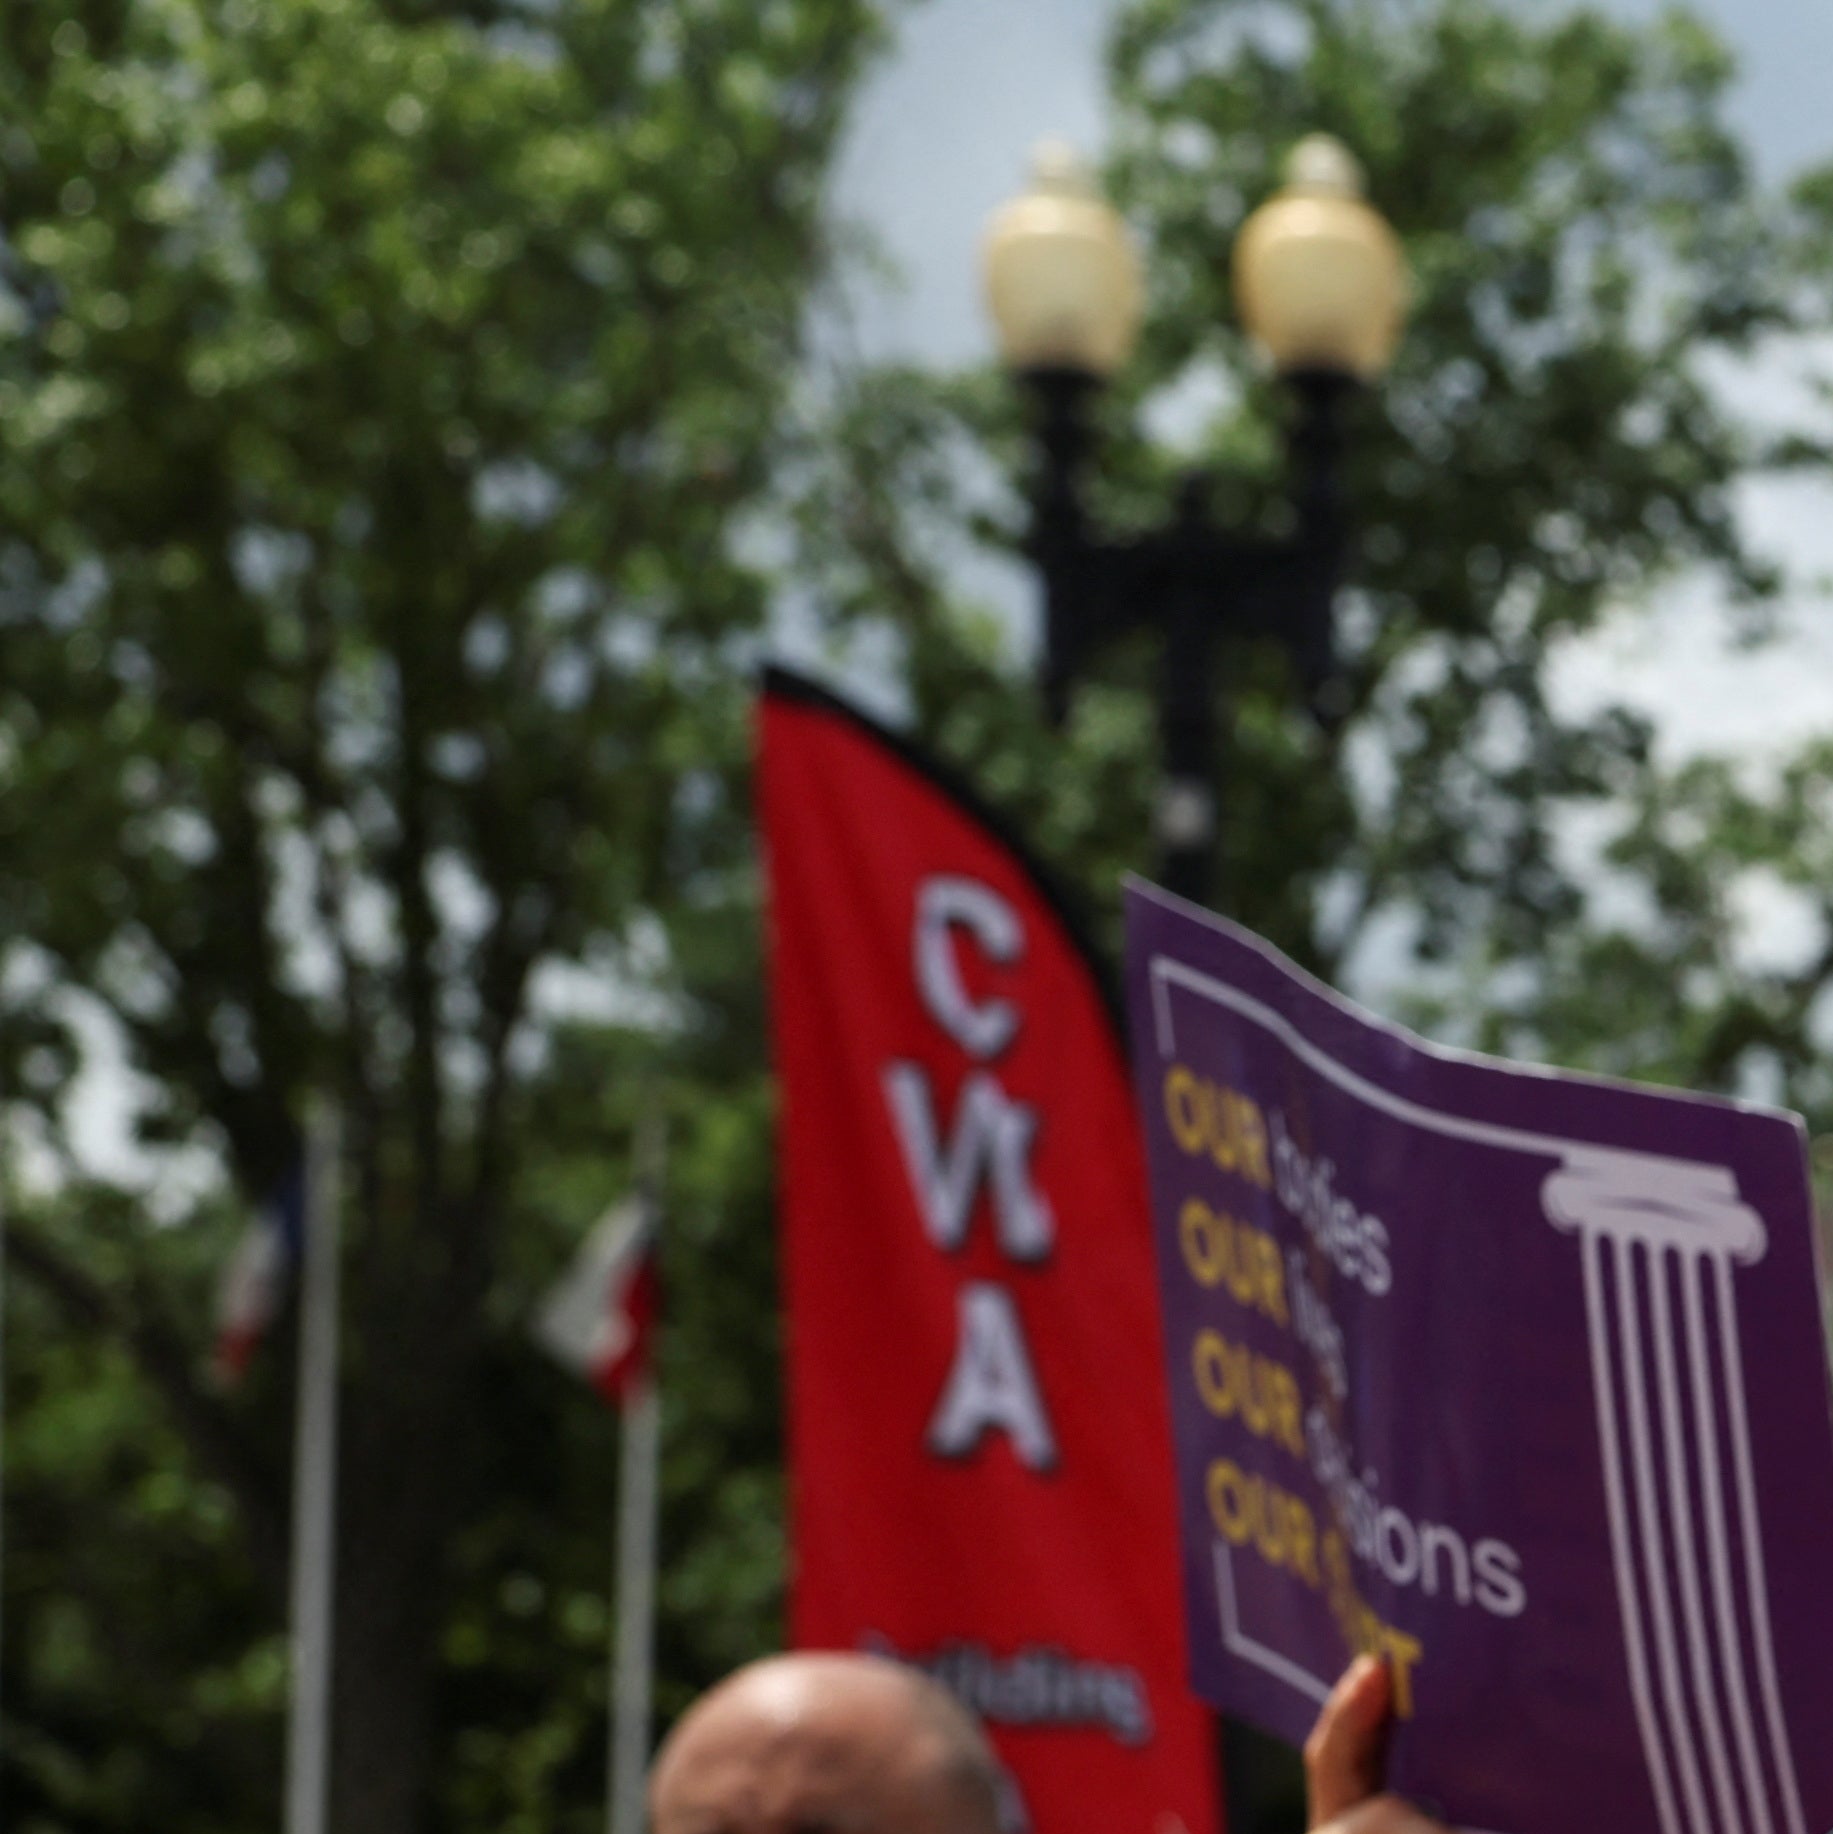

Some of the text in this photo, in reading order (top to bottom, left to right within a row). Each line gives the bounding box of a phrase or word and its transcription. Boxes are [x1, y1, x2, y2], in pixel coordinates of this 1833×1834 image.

[882, 870, 1060, 1474] CWA
[1165, 1064, 1270, 1190] OUR
[1179, 1195, 1288, 1327] OUR
[1193, 1326, 1306, 1459] OUR
[1205, 1457, 1320, 1590] OUR
